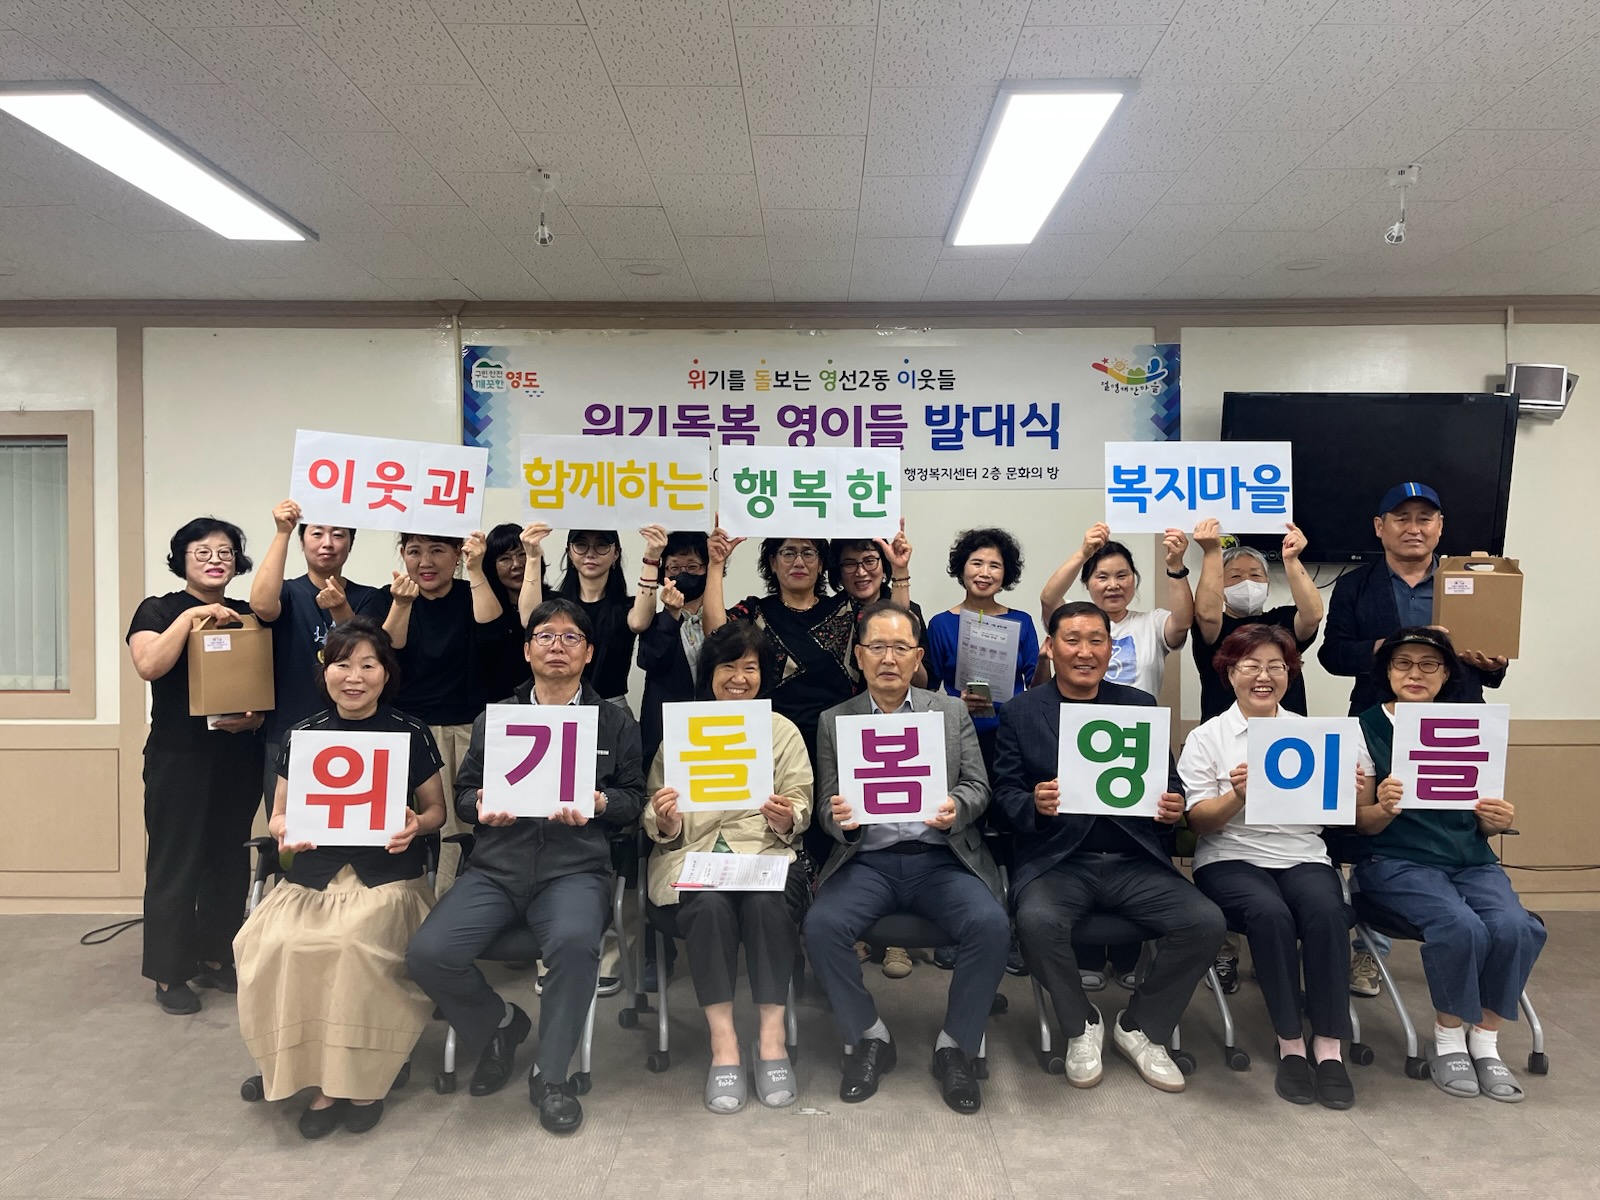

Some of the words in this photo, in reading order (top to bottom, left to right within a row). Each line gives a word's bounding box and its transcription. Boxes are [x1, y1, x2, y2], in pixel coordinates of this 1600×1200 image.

[475, 380, 504, 389] 깨끗한
[505, 371, 540, 389] 영도
[687, 369, 746, 391] 위기를
[753, 369, 812, 391] 돌보는
[819, 369, 890, 391] 영선2동
[897, 369, 956, 391] 이웃들
[776, 404, 908, 450] 영이들
[924, 402, 1060, 451] 발대식
[308, 459, 475, 514] 이웃과
[523, 456, 708, 511] 함께하는
[733, 467, 892, 519] 행복한
[904, 467, 977, 481] 행정복지센터
[982, 466, 1001, 481] 2층
[1006, 466, 1042, 480] 문화의
[1047, 466, 1060, 480] 방
[1108, 464, 1290, 514] 복지마을
[505, 722, 578, 802] 기
[680, 715, 757, 803] 돌
[854, 727, 931, 815] 봄
[1077, 719, 1151, 808] 영
[1264, 734, 1340, 810] 이
[1409, 718, 1489, 800] 들
[306, 745, 390, 830] 위
